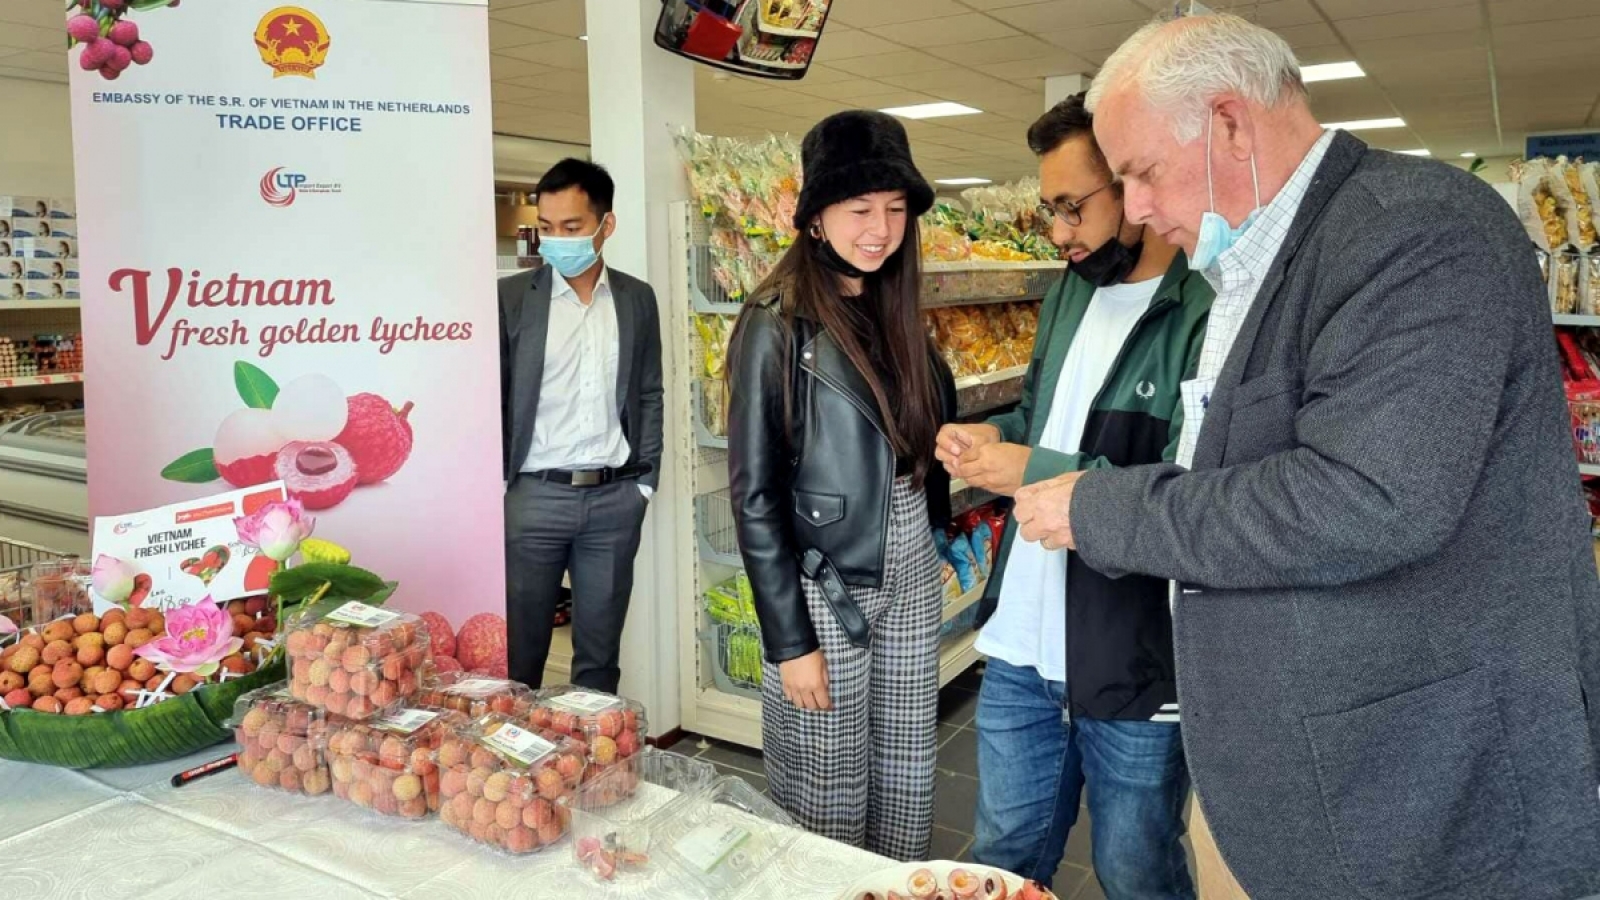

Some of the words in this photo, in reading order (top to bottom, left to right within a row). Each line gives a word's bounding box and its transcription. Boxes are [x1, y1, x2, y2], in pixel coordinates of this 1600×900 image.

[92, 92, 161, 104] EMBASSY
[164, 94, 183, 105] OF
[188, 95, 216, 106] THE
[219, 96, 245, 107] S.R.
[249, 97, 267, 108] OF
[271, 98, 329, 110] VIETNAM
[332, 99, 345, 110] IN
[349, 100, 374, 111] THE
[378, 101, 470, 114] NETHERLANDS
[216, 114, 286, 130] TRADE
[291, 116, 362, 132] OFFICE
[276, 173, 306, 188] LTP
[108, 267, 335, 346] Vietnam
[161, 318, 249, 360] fresh
[259, 317, 359, 357] golden
[368, 315, 473, 354] lychees
[148, 528, 193, 544] VIETNAM
[134, 543, 167, 559] FRESH
[168, 537, 207, 553] LYCHEE
